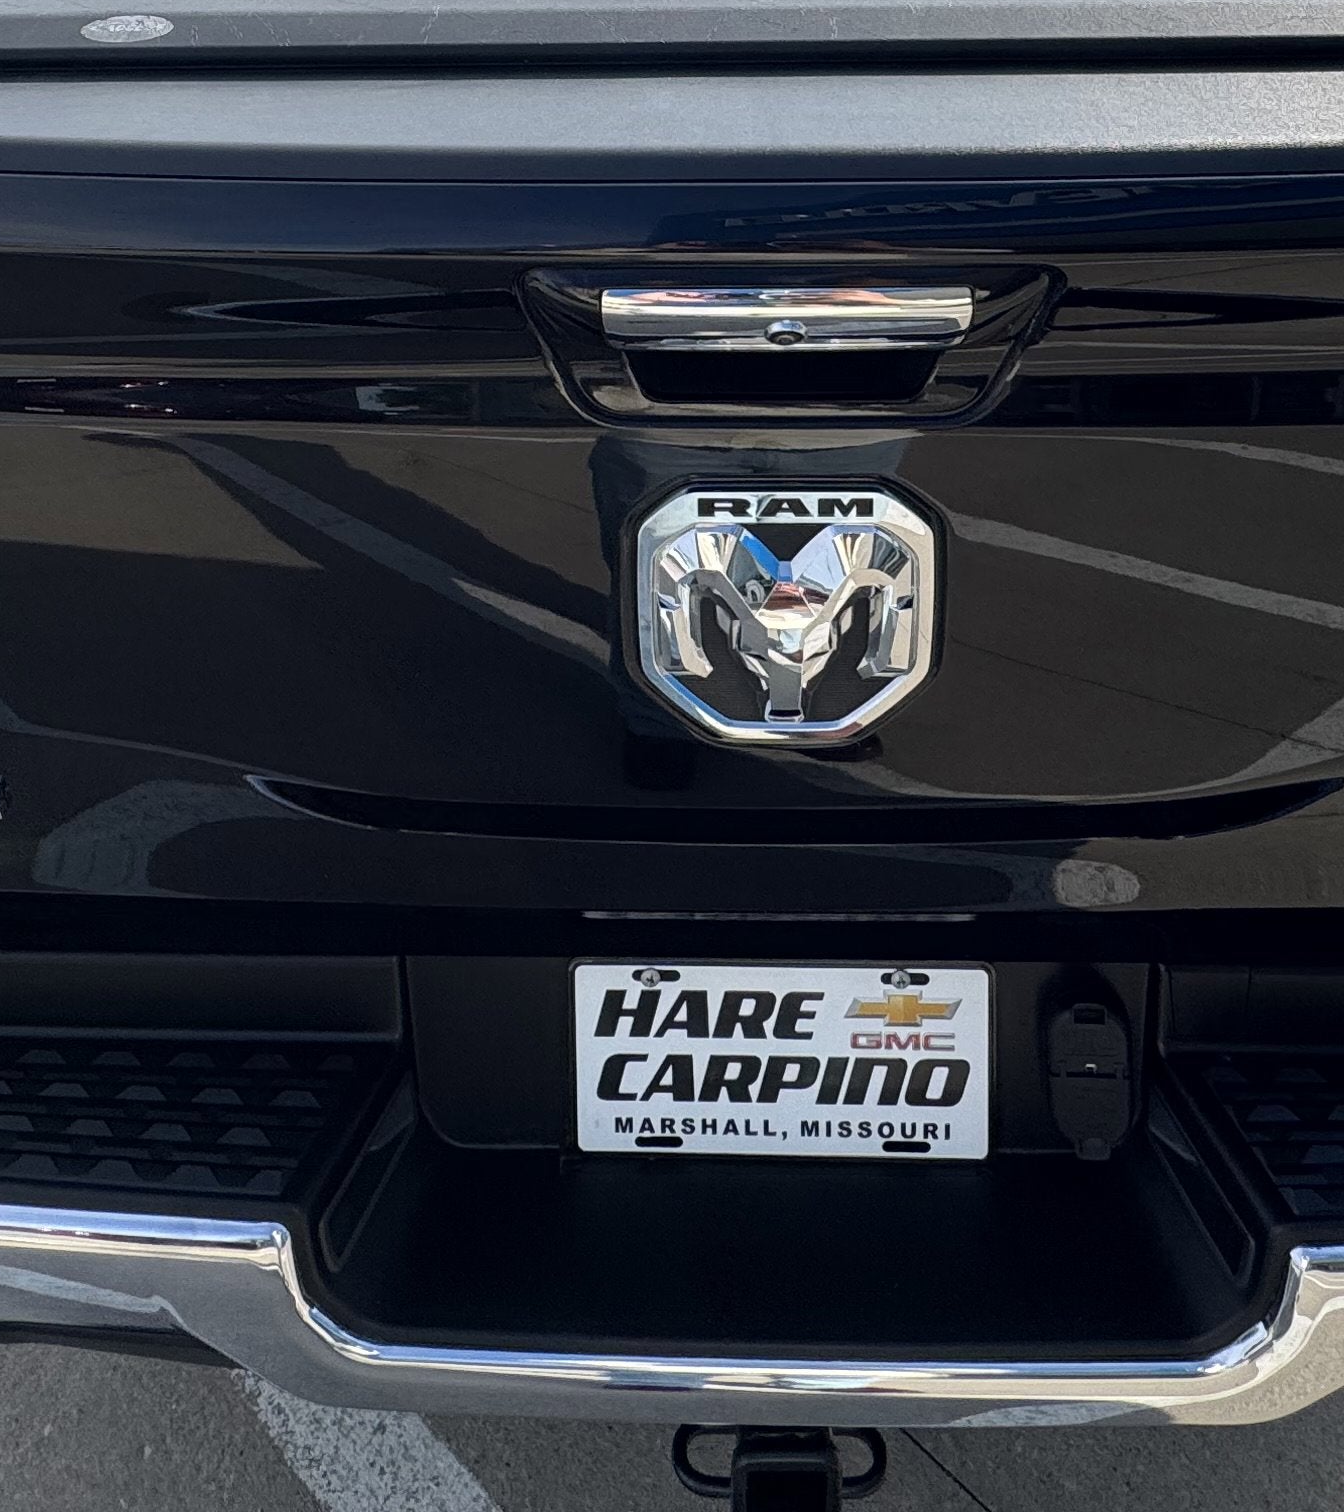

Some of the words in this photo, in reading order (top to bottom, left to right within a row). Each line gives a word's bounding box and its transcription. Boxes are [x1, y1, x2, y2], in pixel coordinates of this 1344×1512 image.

[697, 498, 874, 517] RAM
[593, 989, 825, 1040] HARE
[850, 1032, 956, 1051] GMC
[596, 1053, 971, 1107] CARPINO
[614, 1117, 788, 1140] MARSHALL,
[800, 1119, 952, 1141] MISSOURI
